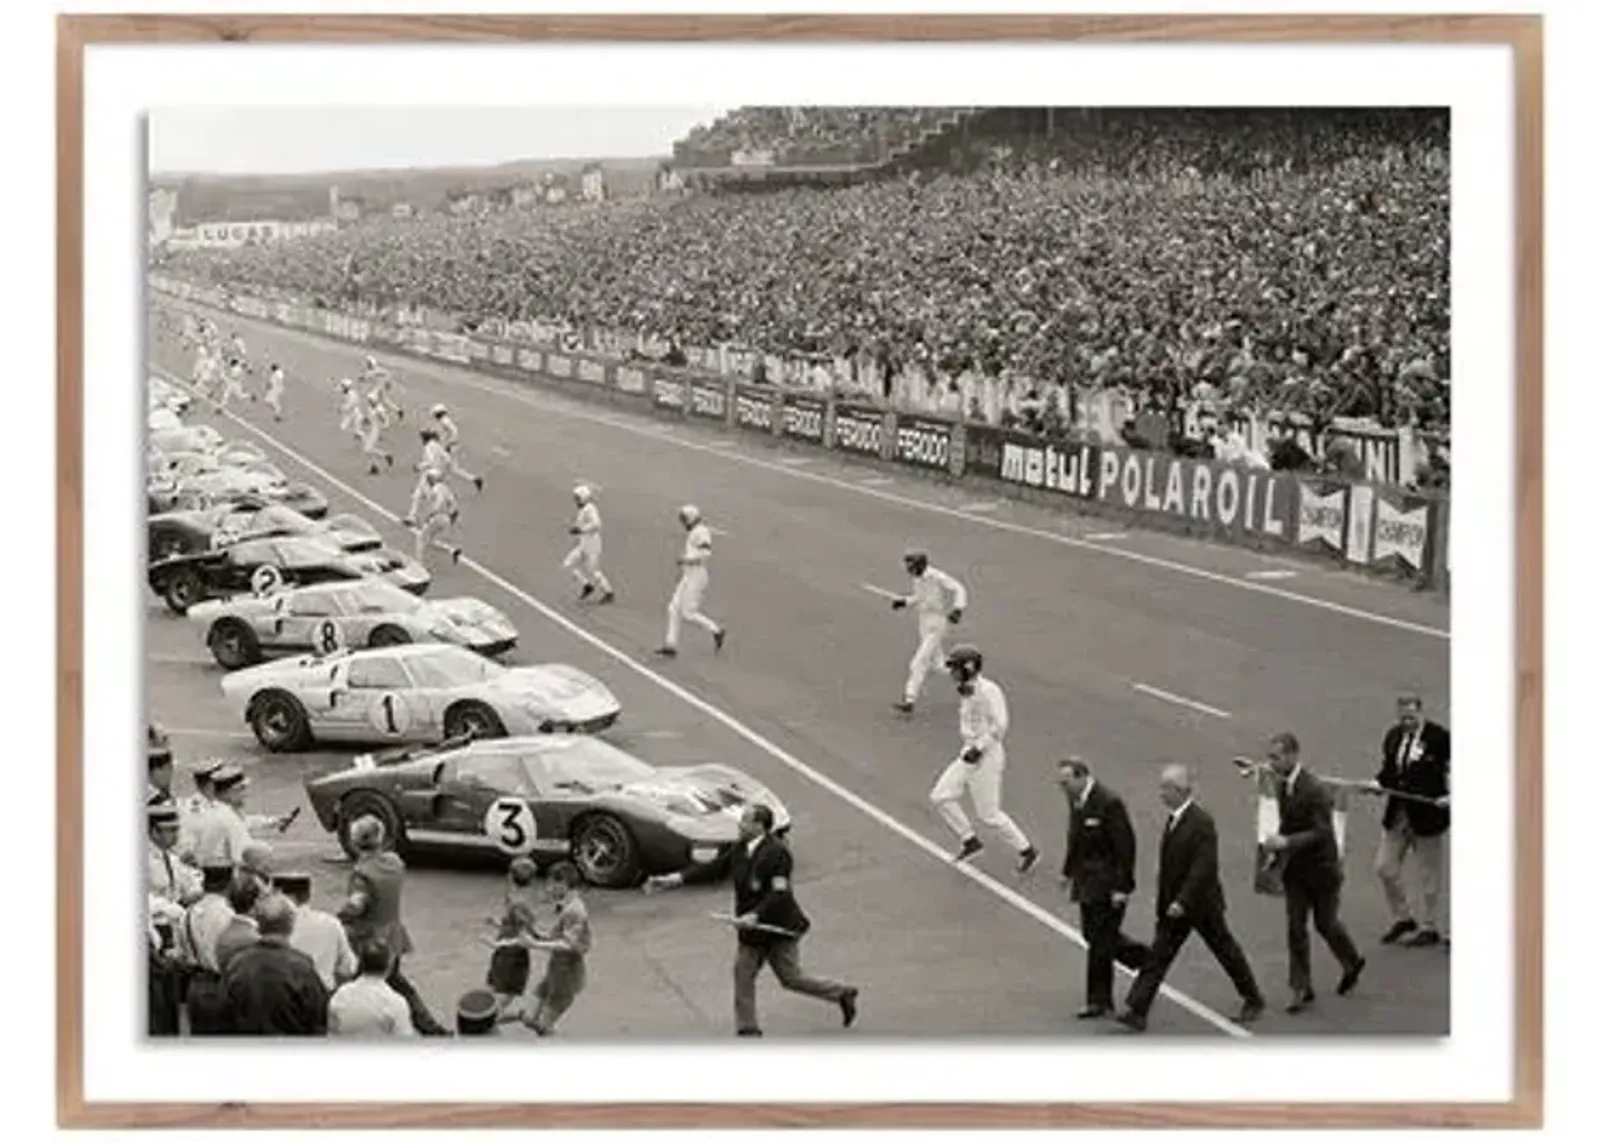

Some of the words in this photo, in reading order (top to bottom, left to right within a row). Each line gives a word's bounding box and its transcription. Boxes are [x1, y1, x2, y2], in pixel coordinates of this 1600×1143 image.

[898, 427, 949, 467] FERODO
[1099, 450, 1284, 536] POLAROIL
[320, 620, 338, 653] 8
[382, 695, 399, 733] 1
[497, 803, 526, 848] 3
